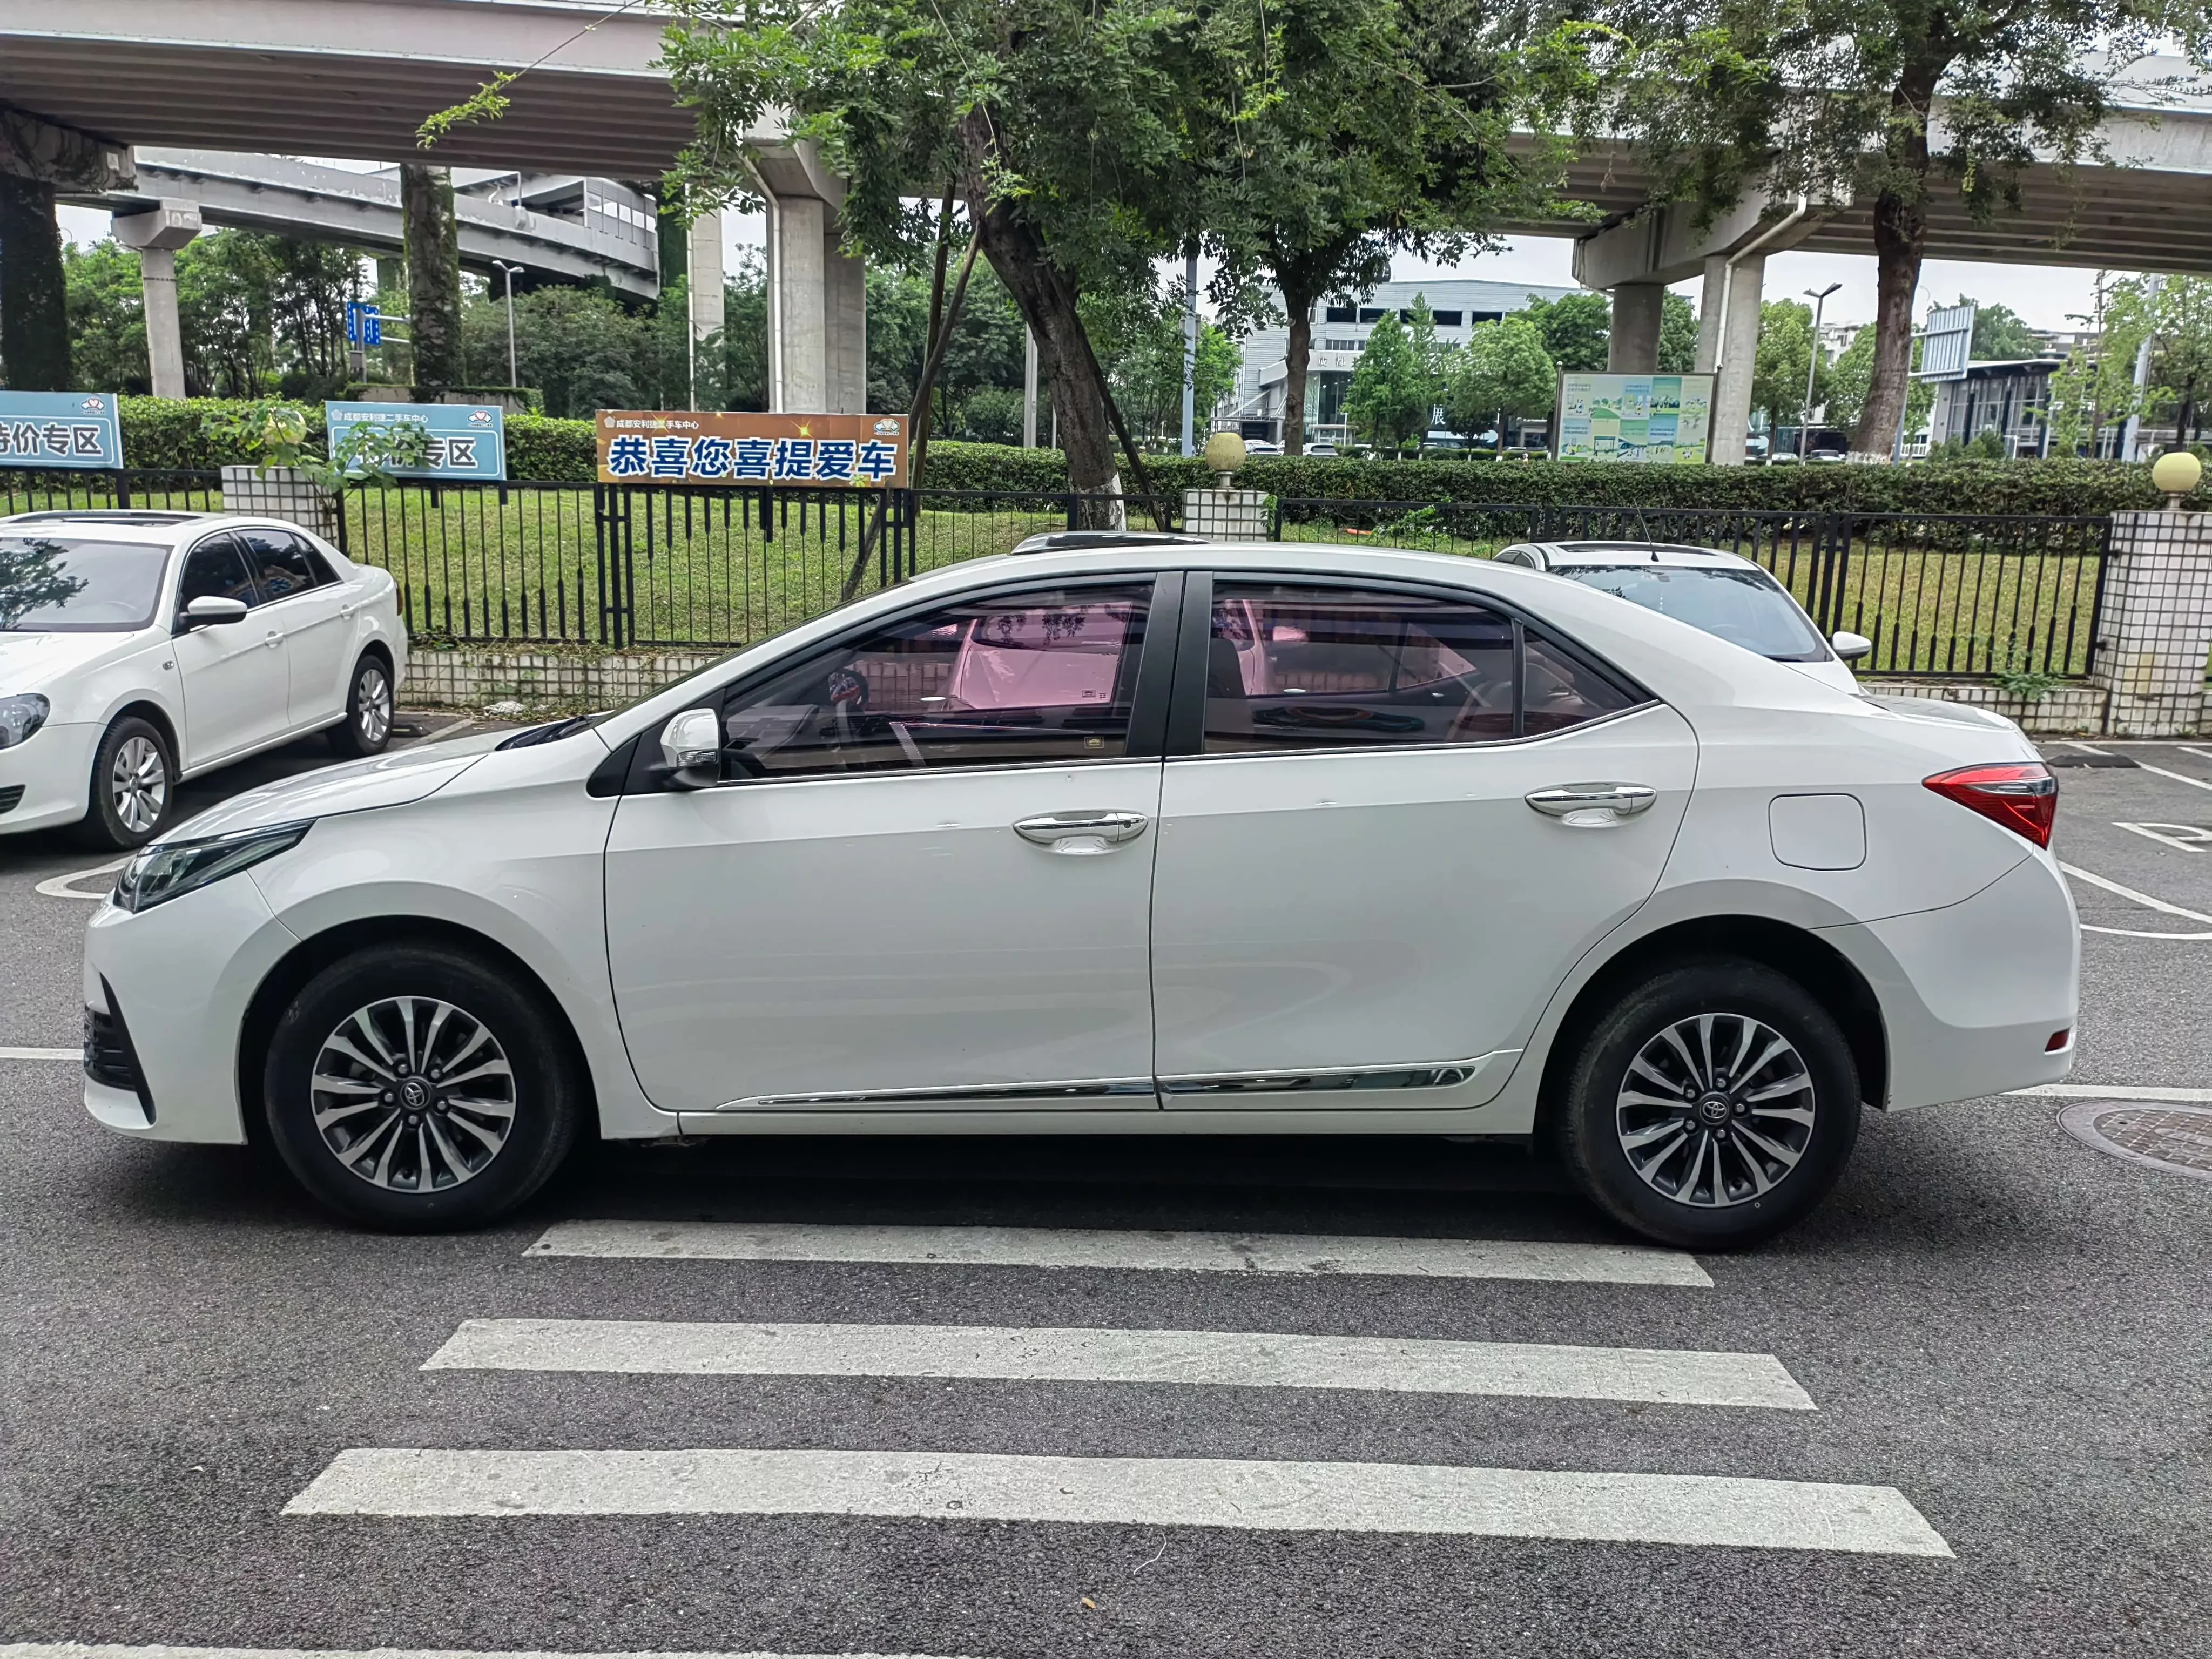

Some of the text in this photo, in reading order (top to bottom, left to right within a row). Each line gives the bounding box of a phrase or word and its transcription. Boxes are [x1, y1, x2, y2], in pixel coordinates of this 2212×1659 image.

[606, 434, 898, 482] 恭喜您喜提爱车
